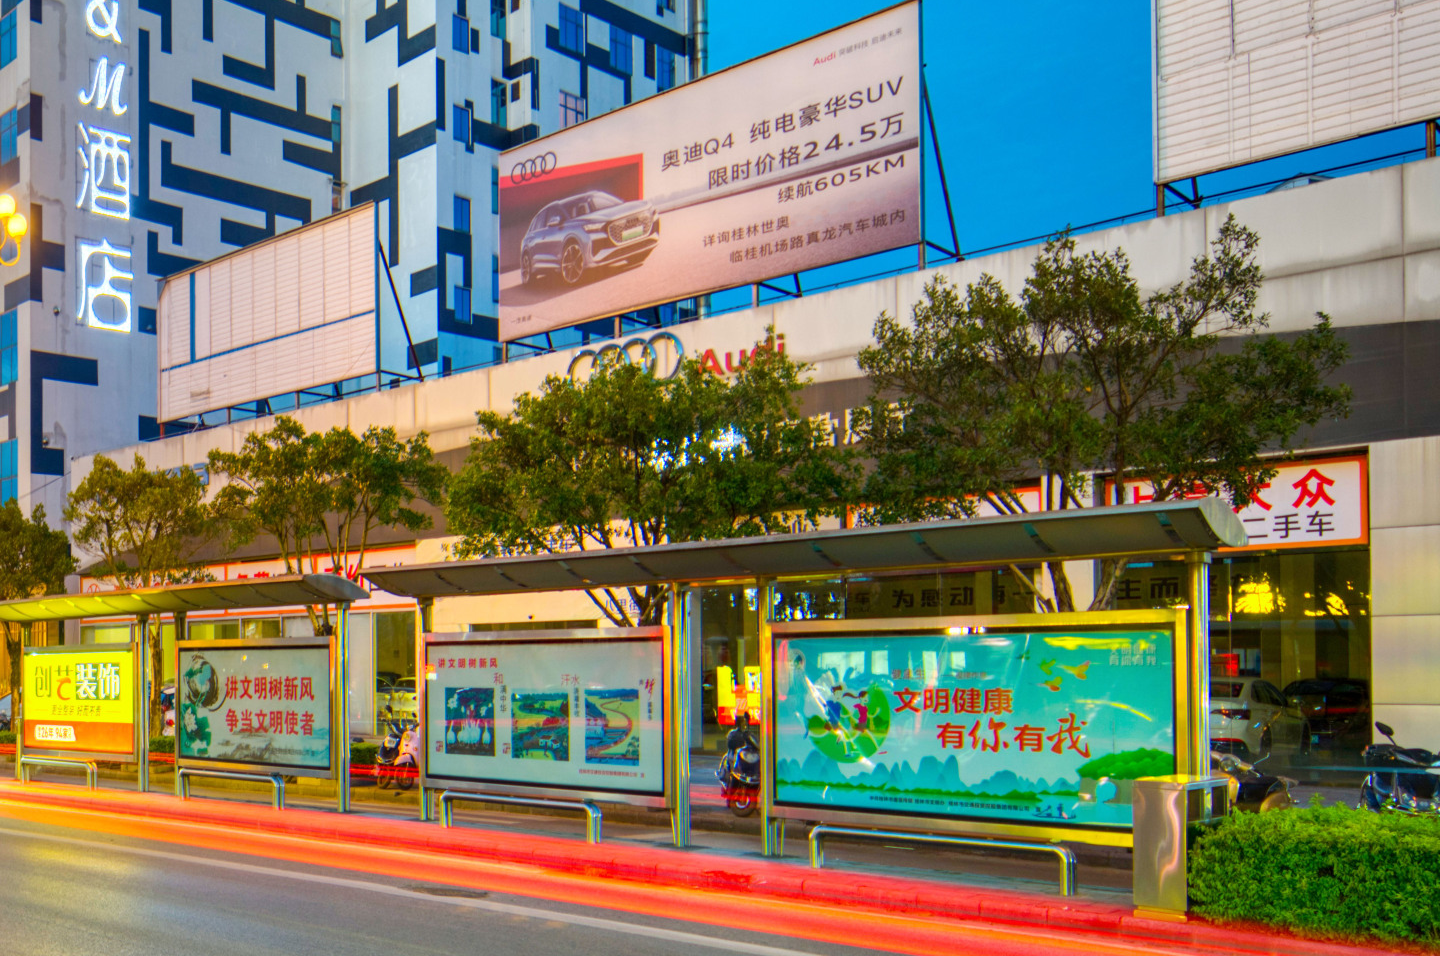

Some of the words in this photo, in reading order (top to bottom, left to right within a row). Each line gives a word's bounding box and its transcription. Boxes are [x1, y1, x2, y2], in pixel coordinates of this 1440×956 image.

[812, 50, 837, 67] Audi
[661, 131, 735, 173] 奥迪Q4
[749, 76, 905, 143] 纯电豪华SUV
[707, 111, 905, 190] 限时价格24.5万
[777, 154, 906, 204] 续航605KM
[702, 215, 790, 248] 详询桂林世奥
[729, 209, 906, 264] 临桂机场路真龙汽车城内
[1242, 510, 1335, 539] 二手车
[437, 657, 498, 669] 讲文明树新风
[225, 676, 315, 701] 讲文明树新风
[493, 672, 504, 685] 和
[561, 673, 581, 687] 汗水
[893, 687, 1013, 715] 文明健康
[225, 710, 315, 737] 争当文明使者
[936, 712, 1091, 759] 有你有我
